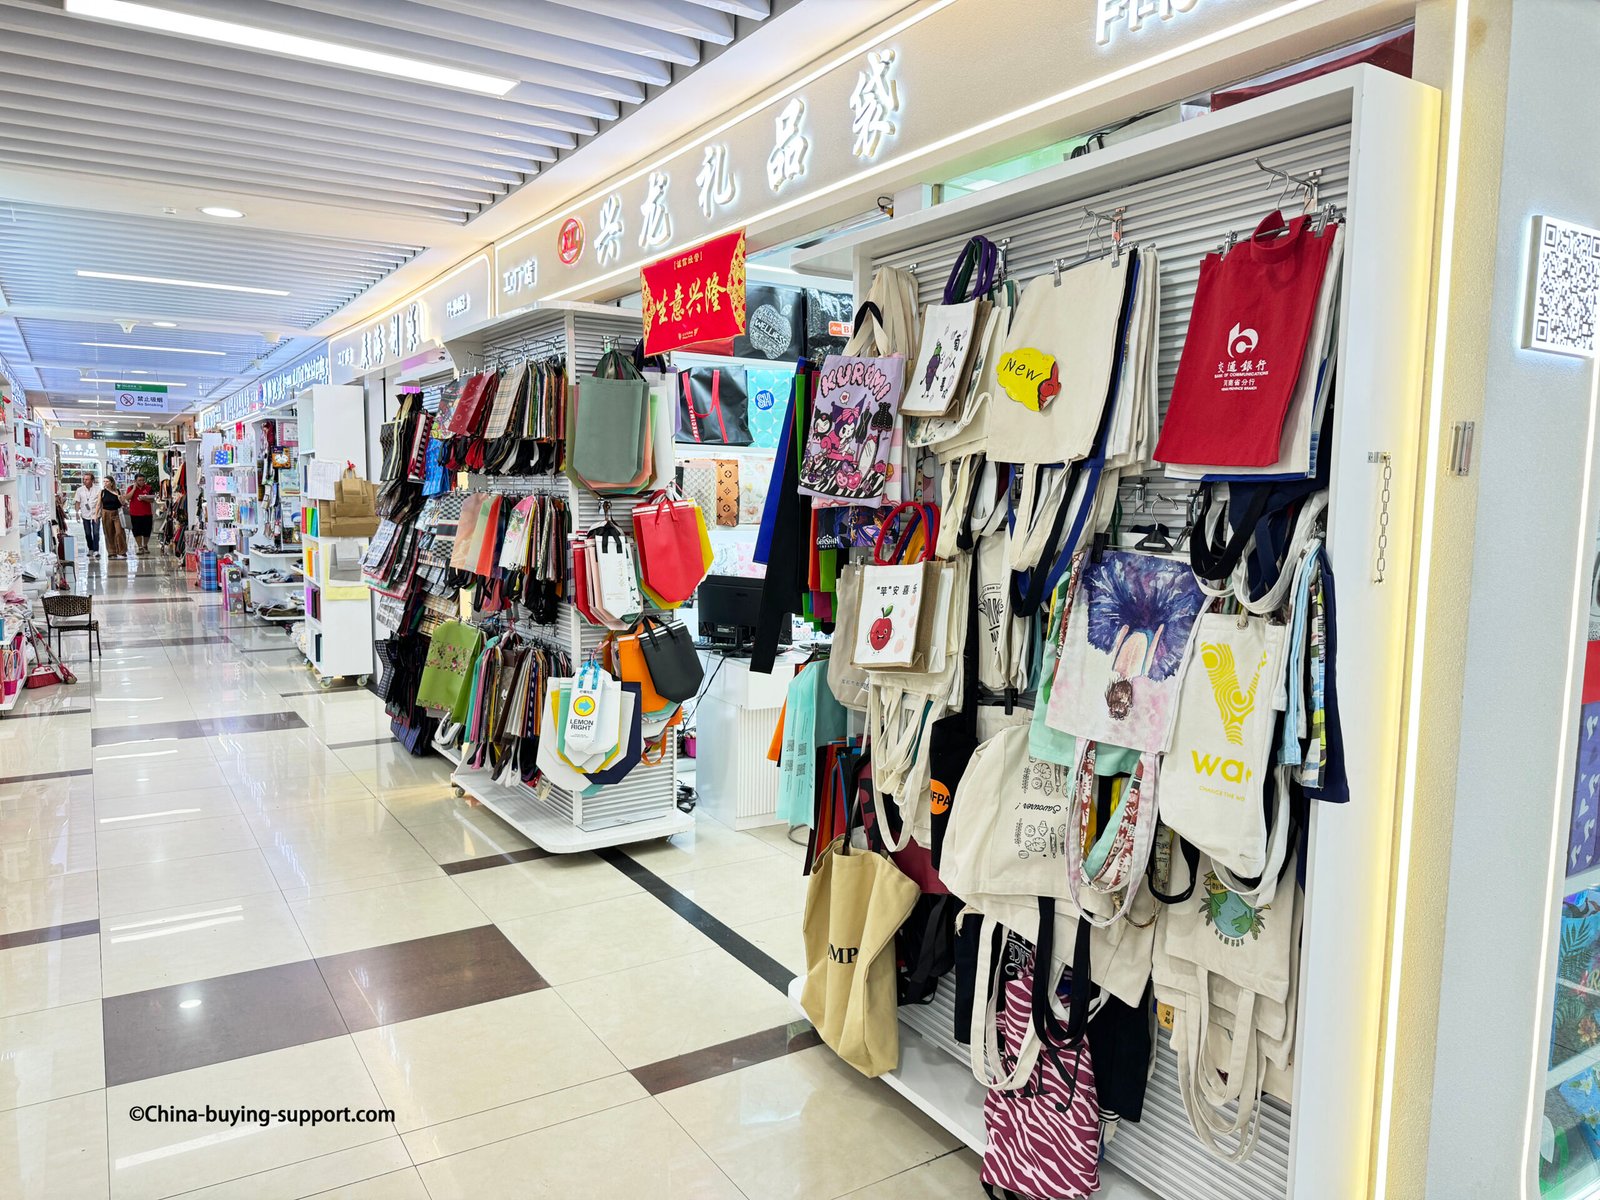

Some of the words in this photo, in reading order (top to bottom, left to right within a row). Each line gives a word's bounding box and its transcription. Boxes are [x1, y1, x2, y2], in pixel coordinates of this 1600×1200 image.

[593, 48, 901, 266] 兴龙礼品袋
[656, 272, 727, 325] 生意兴隆
[754, 319, 787, 345] WELLNESS
[820, 362, 892, 402] KUROMI
[1002, 356, 1044, 381] New
[570, 718, 594, 726] LEMON
